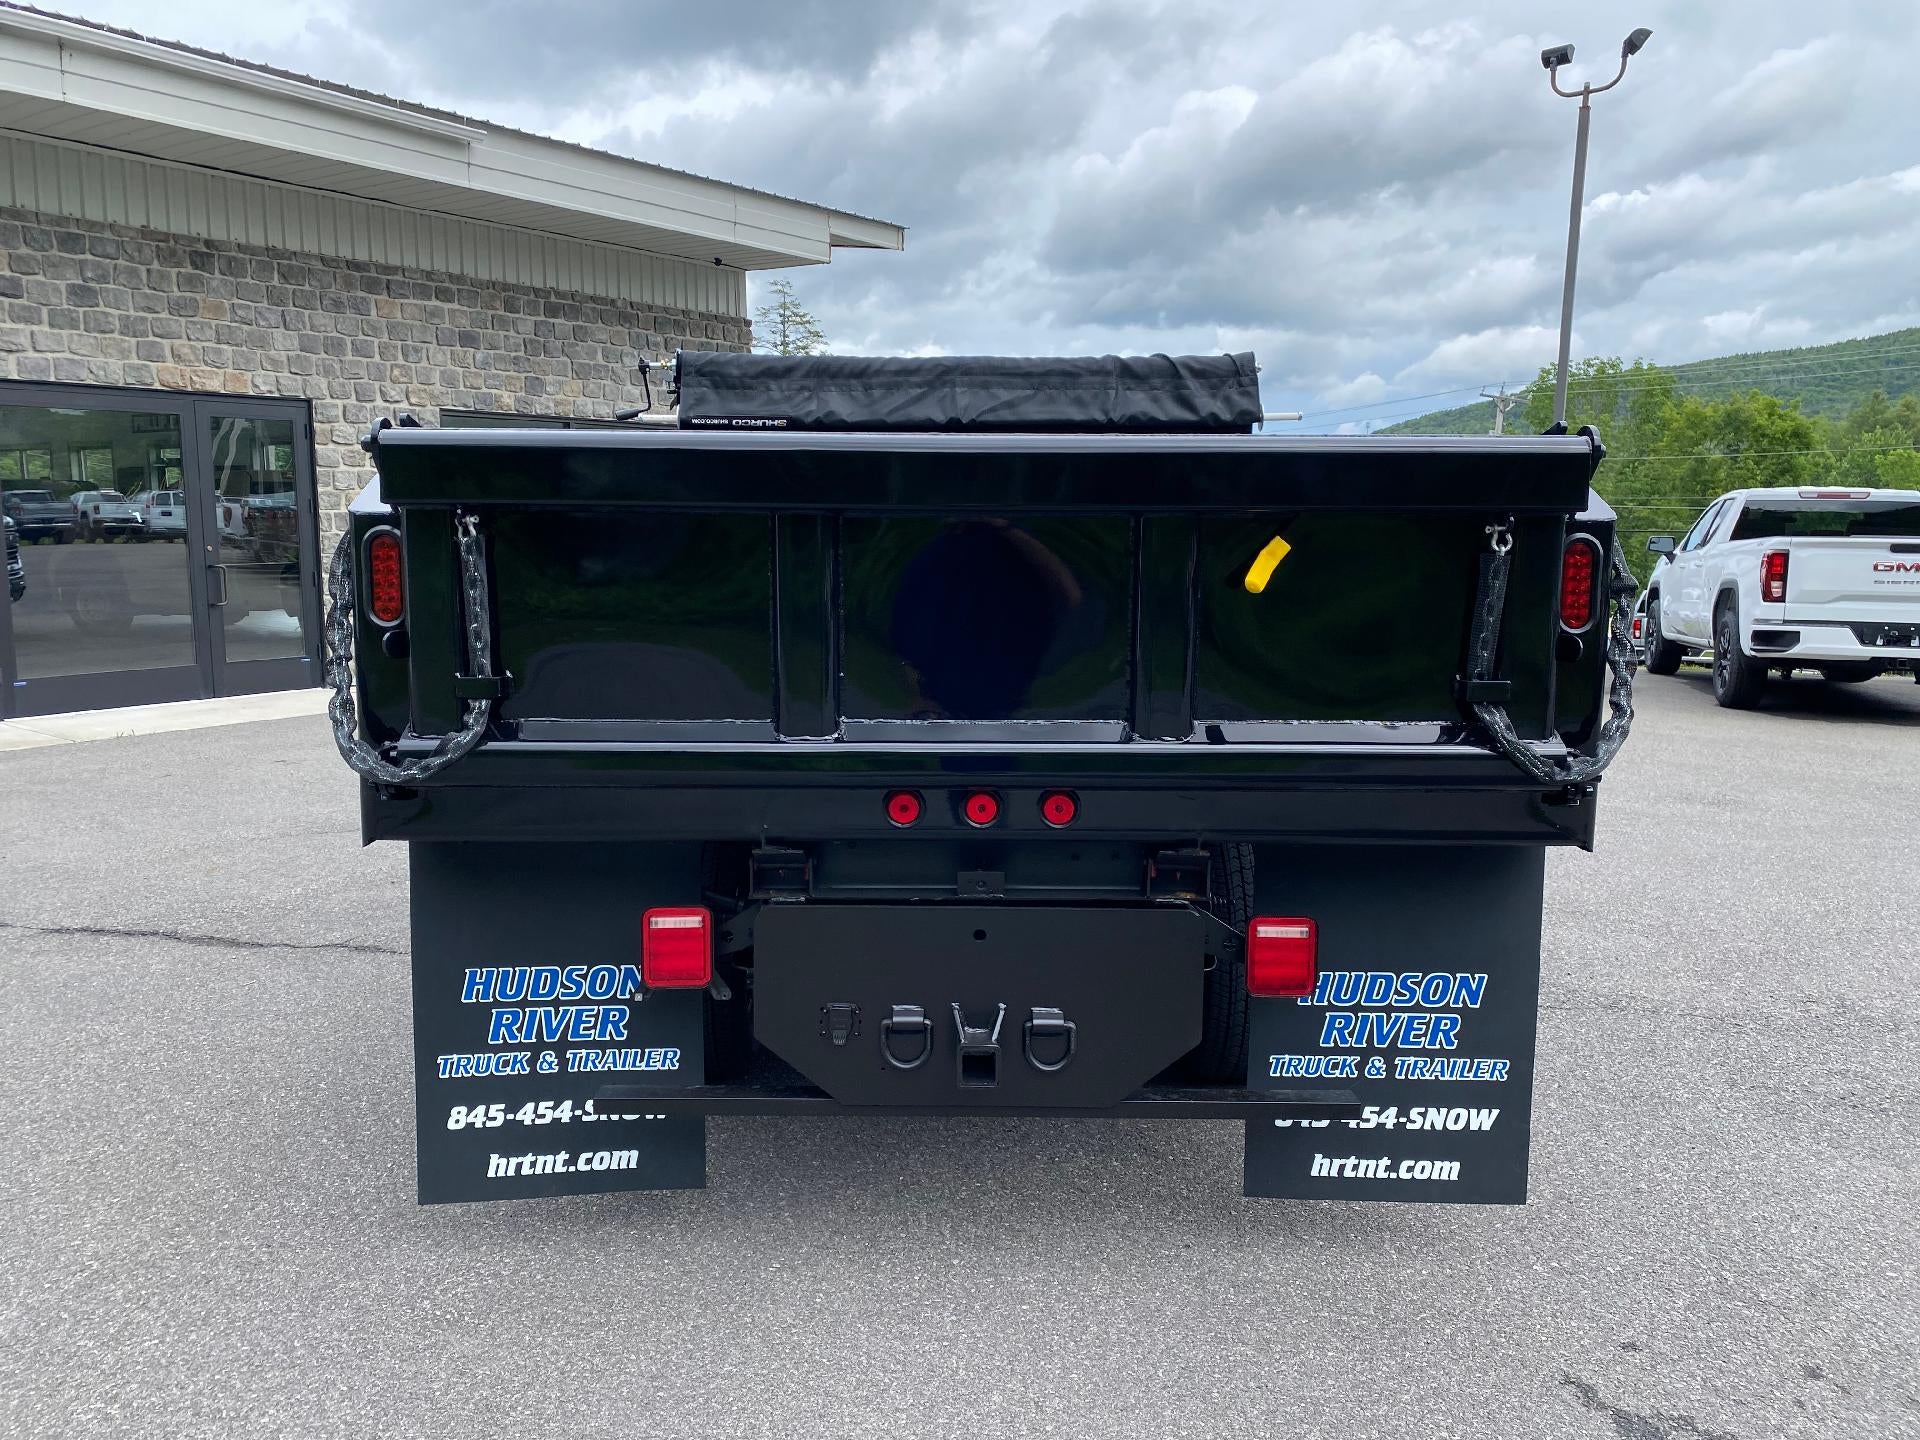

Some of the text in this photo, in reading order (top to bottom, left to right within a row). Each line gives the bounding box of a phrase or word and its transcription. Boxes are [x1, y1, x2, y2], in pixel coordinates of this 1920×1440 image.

[461, 965, 642, 1003] HUDSON
[1297, 972, 1488, 1008] HUDSON
[488, 1005, 630, 1044] RIVER
[1319, 1012, 1461, 1050] RIVER
[437, 1048, 681, 1078] TRUCK & TRAILER
[1269, 1055, 1509, 1081] TRUCK & TRAILER
[447, 1099, 666, 1130] 845-454-S
[1274, 1106, 1500, 1131] 54-SNOW
[487, 1149, 639, 1178] hrtnt.com
[1310, 1153, 1461, 1181] hrtnt.com
